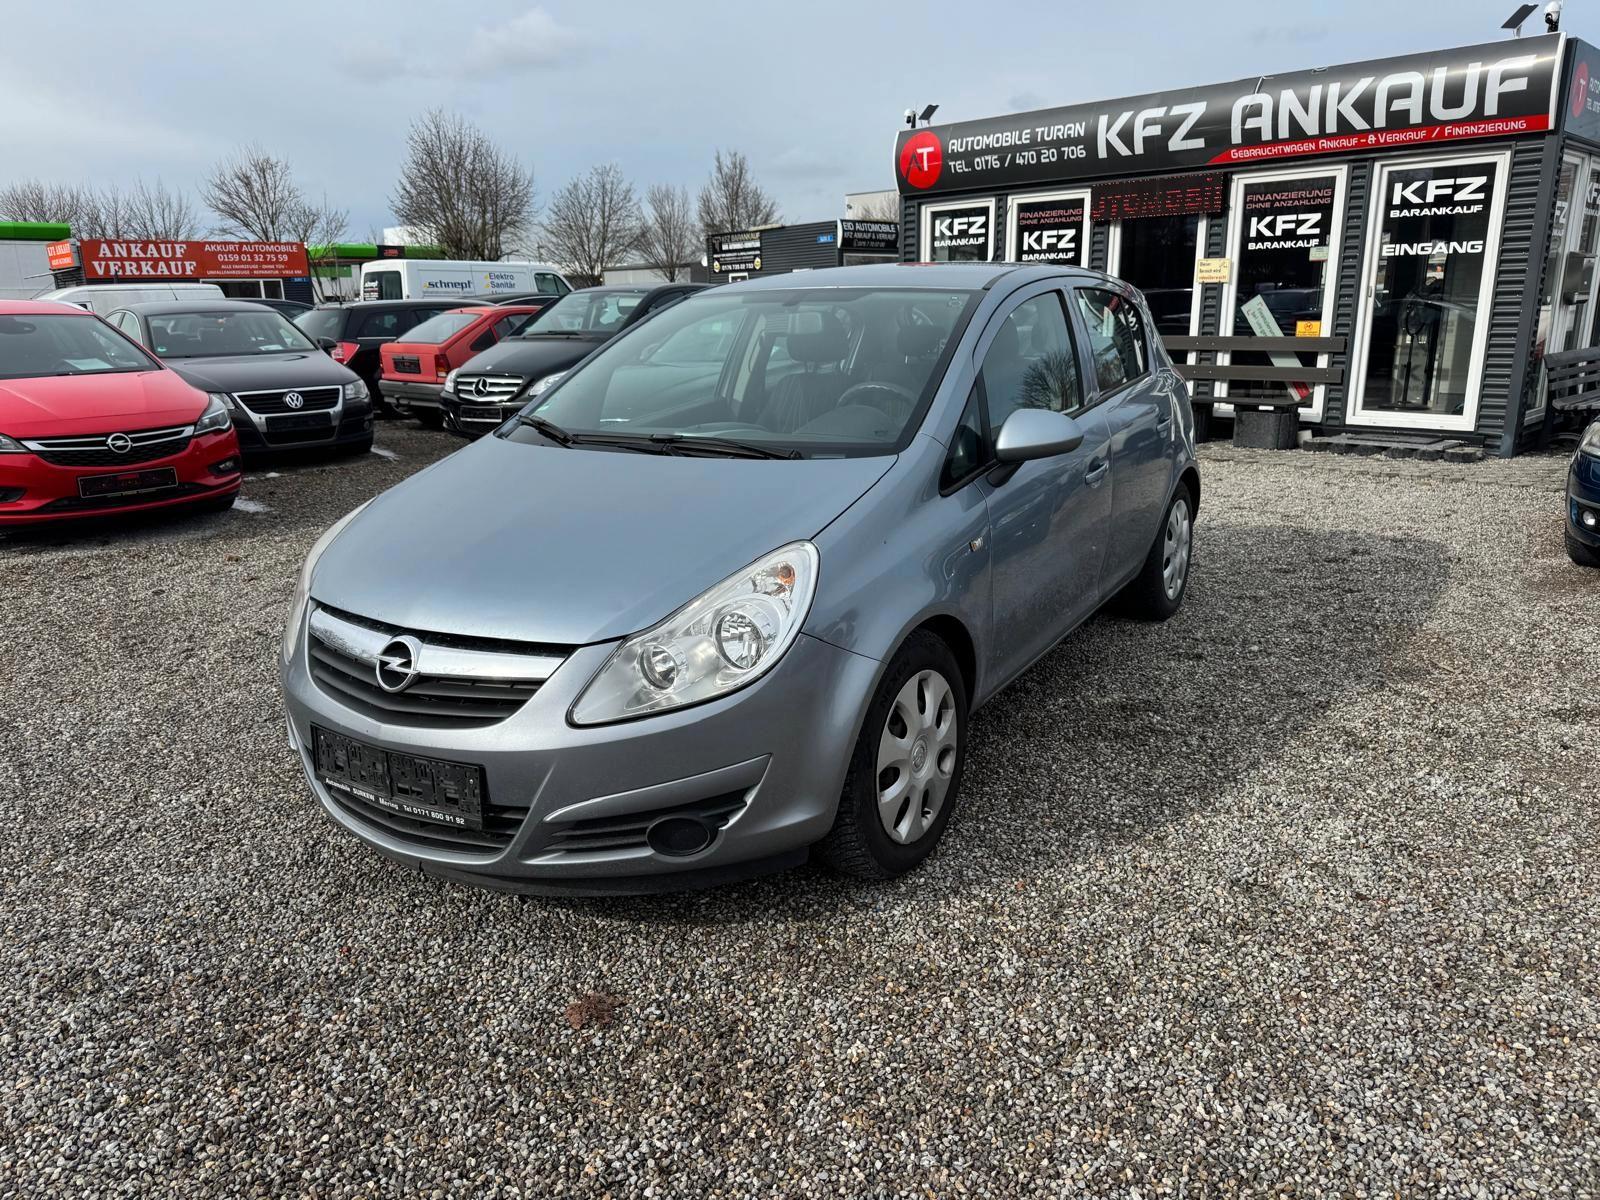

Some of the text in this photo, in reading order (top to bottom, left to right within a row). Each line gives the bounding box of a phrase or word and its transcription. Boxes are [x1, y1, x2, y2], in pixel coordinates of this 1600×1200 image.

[1097, 54, 1537, 159] KFZ ANKAUF
[948, 121, 1086, 153] AUTOMOBILE TURAN
[949, 160, 972, 174] TEL.
[974, 154, 1001, 170] 0176
[1015, 151, 1037, 166] 470
[1040, 148, 1058, 163] 20
[1060, 145, 1087, 161] 706
[1246, 187, 1332, 202] FINANZIERUNG
[1392, 175, 1488, 205] KFZ
[1246, 197, 1331, 210] OHNE ANZAHLUNG
[1019, 207, 1083, 220] FINANZIERUNG
[1390, 204, 1483, 218] BARANKAUF
[934, 216, 986, 238] KFZ
[1019, 214, 1083, 226] OHNE ANZAHLUNG
[1250, 213, 1322, 238] KFZ
[856, 222, 896, 233] AUTOMOBILE
[934, 236, 986, 248] BARANKAUF
[1022, 229, 1076, 251] KFZ
[1248, 238, 1320, 251] BARANKAUF
[98, 243, 187, 258] ANKAUF
[205, 244, 298, 253] AKKURT AUTOMOBILE
[1381, 240, 1484, 257] EINGANG
[278, 254, 289, 262] 59
[1021, 251, 1076, 262] BARANKAUF
[92, 261, 197, 276] VERKAUF
[488, 272, 514, 281] Elektro
[428, 280, 473, 292] schnepf
[490, 280, 516, 289] Sanitär
[326, 778, 351, 792] Automobile
[379, 797, 398, 810] Mering
[413, 807, 430, 817] 0171
[431, 811, 444, 820] 800
[445, 814, 454, 822] 91
[455, 817, 465, 825] 92
